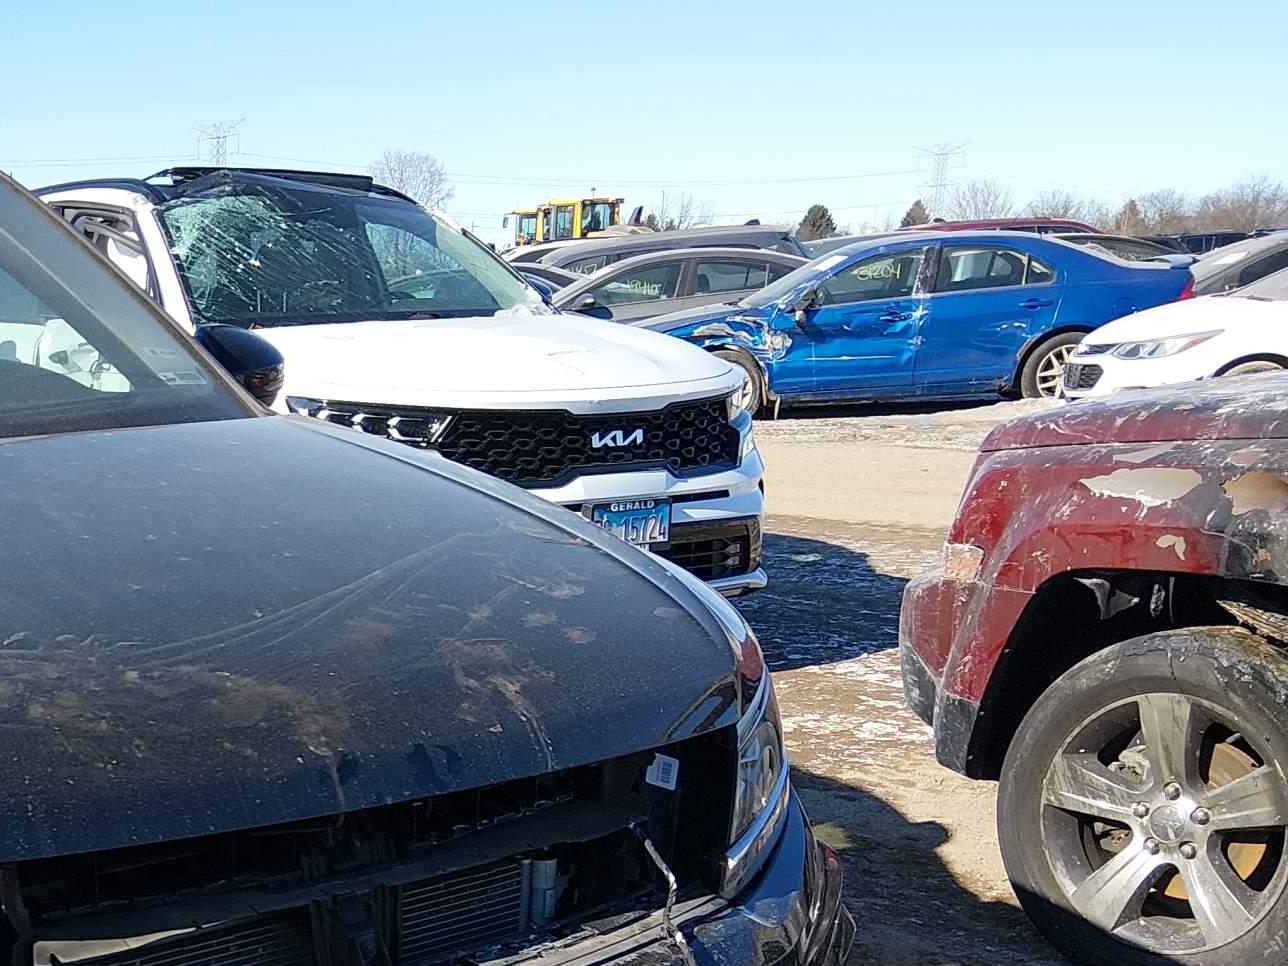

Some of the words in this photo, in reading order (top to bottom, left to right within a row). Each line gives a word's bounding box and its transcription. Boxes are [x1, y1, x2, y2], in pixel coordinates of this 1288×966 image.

[592, 428, 644, 448] KIA
[610, 500, 655, 512] GERALD
[620, 513, 666, 542] 15724
